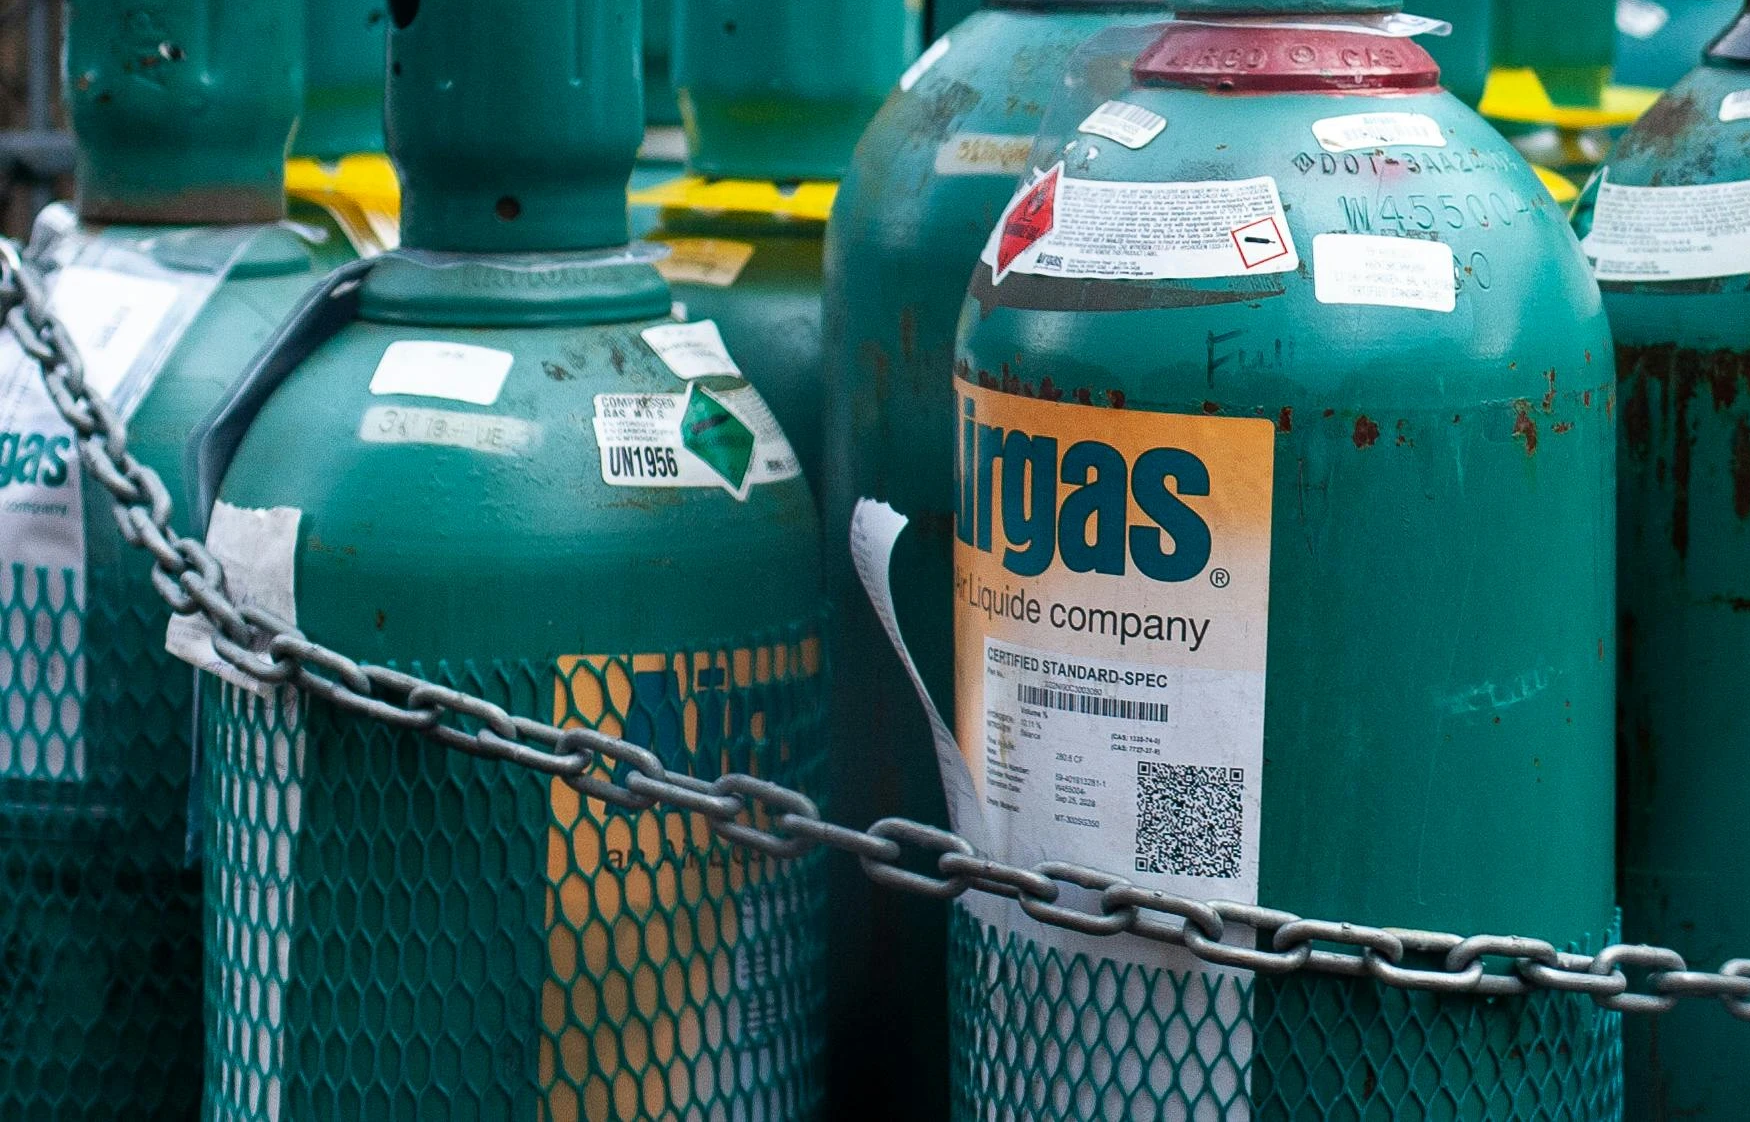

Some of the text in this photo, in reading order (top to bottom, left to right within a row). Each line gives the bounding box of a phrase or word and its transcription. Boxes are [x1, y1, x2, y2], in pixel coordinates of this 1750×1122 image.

[609, 446, 679, 478] UN1956
[969, 572, 1042, 625] Liquide
[1049, 601, 1212, 652] company
[987, 646, 1168, 689] CERTIFIED STANDARD-SPEC
